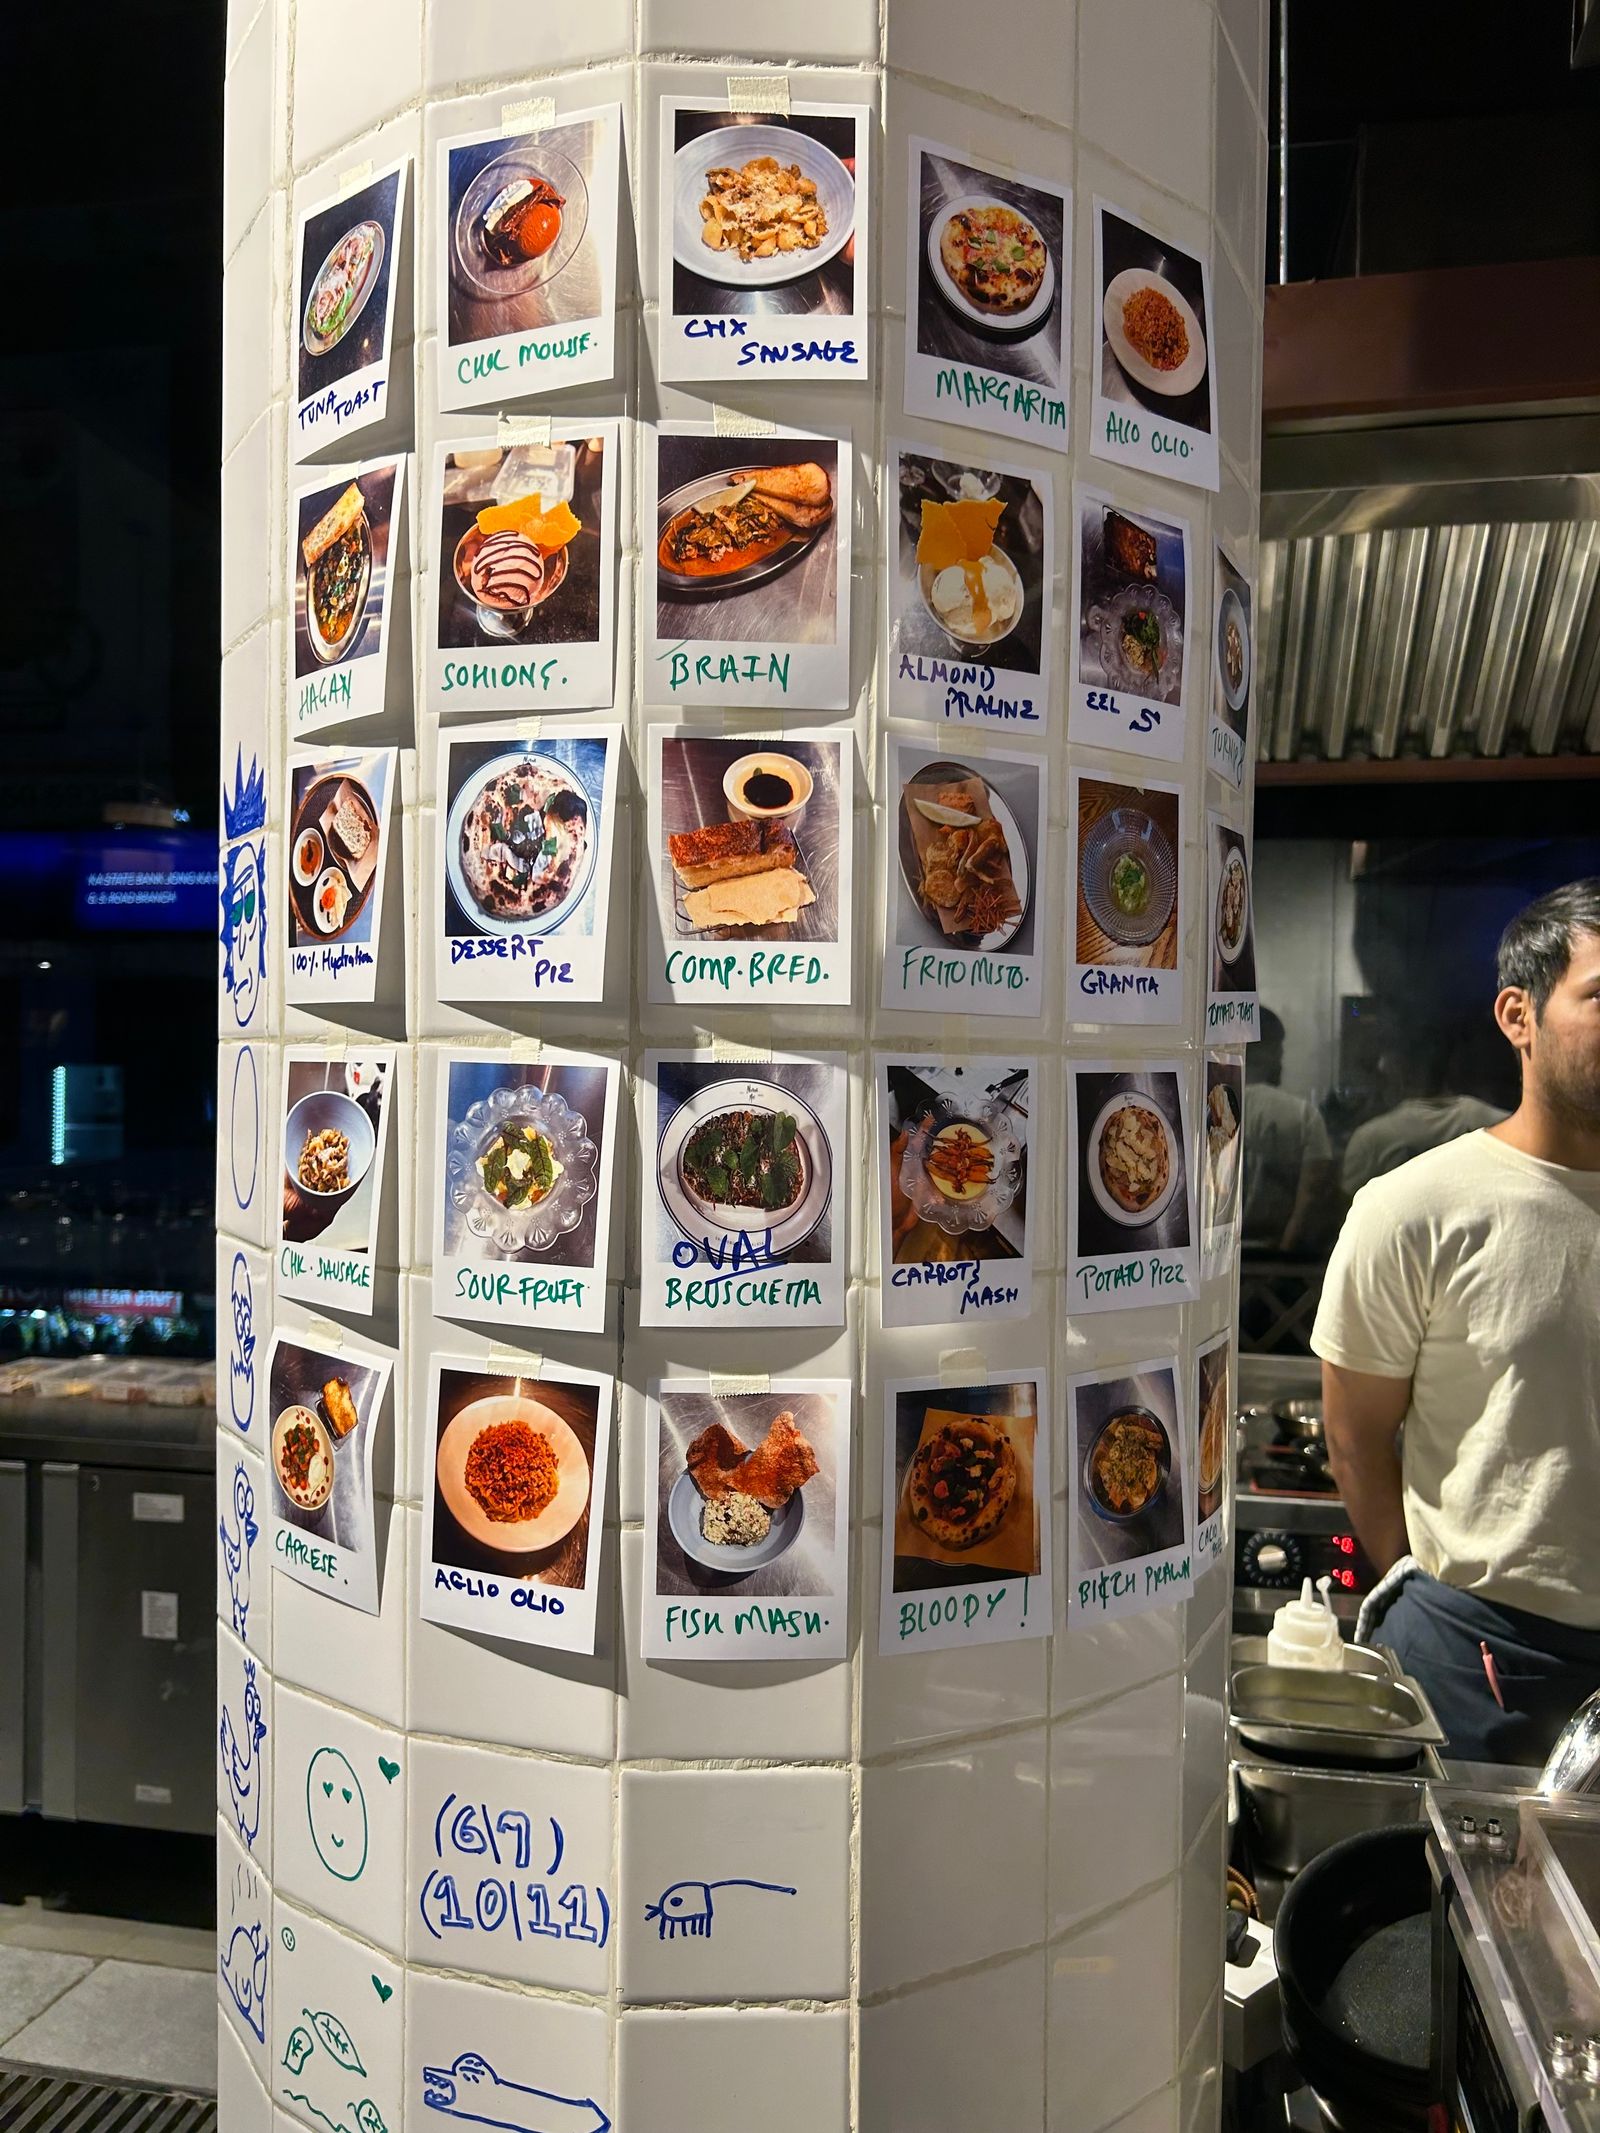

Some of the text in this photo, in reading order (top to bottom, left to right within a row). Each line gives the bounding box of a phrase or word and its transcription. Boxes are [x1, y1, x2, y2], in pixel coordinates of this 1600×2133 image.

[737, 340, 858, 366] SAUSAGE
[298, 380, 386, 430] TUNA TOAST
[936, 368, 1066, 430] MARGARITA
[669, 652, 790, 693] BRAIN
[899, 654, 995, 692] ALMOND
[1086, 691, 1121, 714] EEL
[451, 934, 544, 965] DESSERT
[903, 945, 967, 990] FRITO
[672, 1227, 788, 1271] OVAL
[317, 1257, 371, 1288] SAUSAGE
[455, 1267, 518, 1305] SOUR
[1076, 1260, 1144, 1299] POTATO
[960, 1286, 1019, 1315] MASH
[434, 1568, 565, 1616] AGLIO OLIO
[665, 1605, 724, 1643] FISH
